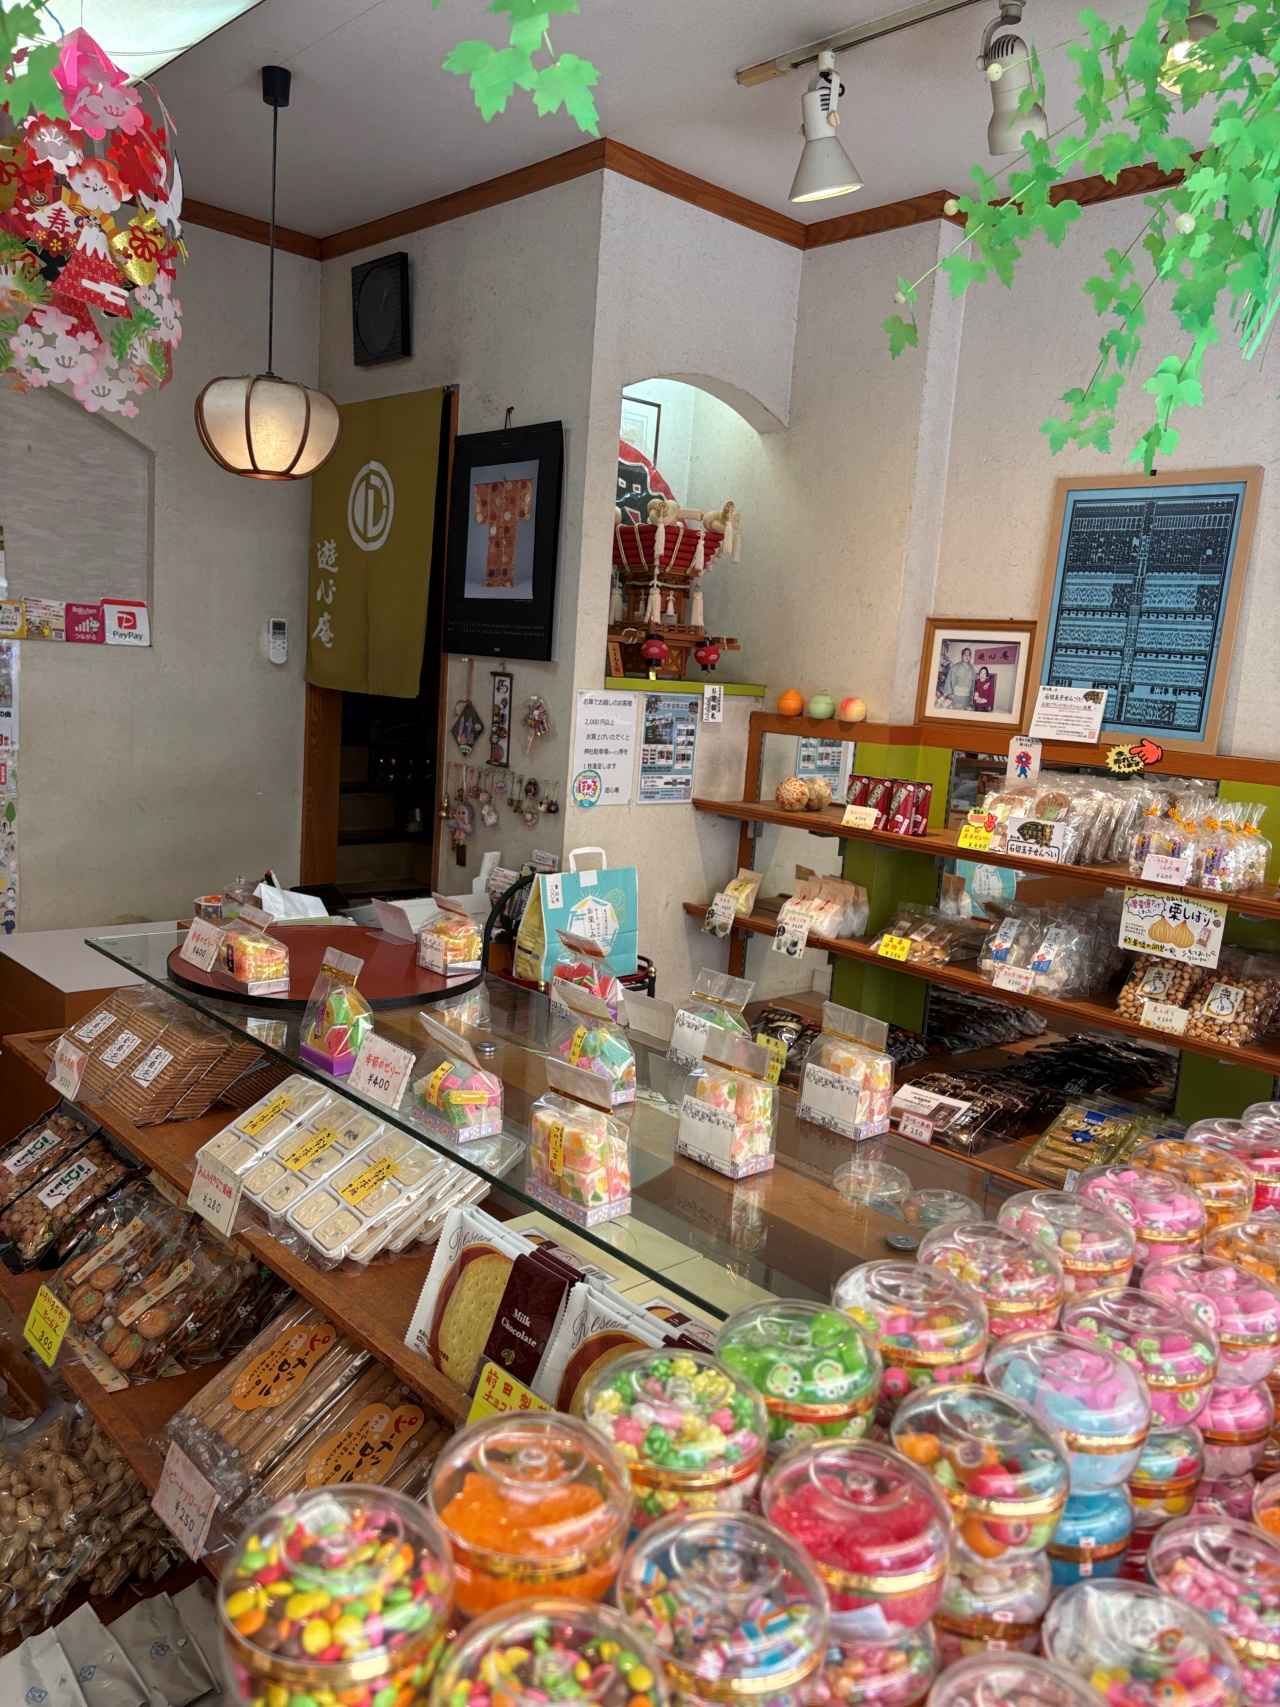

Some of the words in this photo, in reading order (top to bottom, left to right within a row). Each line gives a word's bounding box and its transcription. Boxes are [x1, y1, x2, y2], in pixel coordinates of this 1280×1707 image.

[48, 207, 71, 234] 寿
[312, 539, 338, 648] 遊心庵
[112, 630, 143, 641] PayPay
[1169, 902, 1211, 928] 栗しぼり
[367, 1073, 391, 1091] ¥400
[512, 1308, 532, 1328] Milk
[500, 1316, 538, 1347] Chocolate
